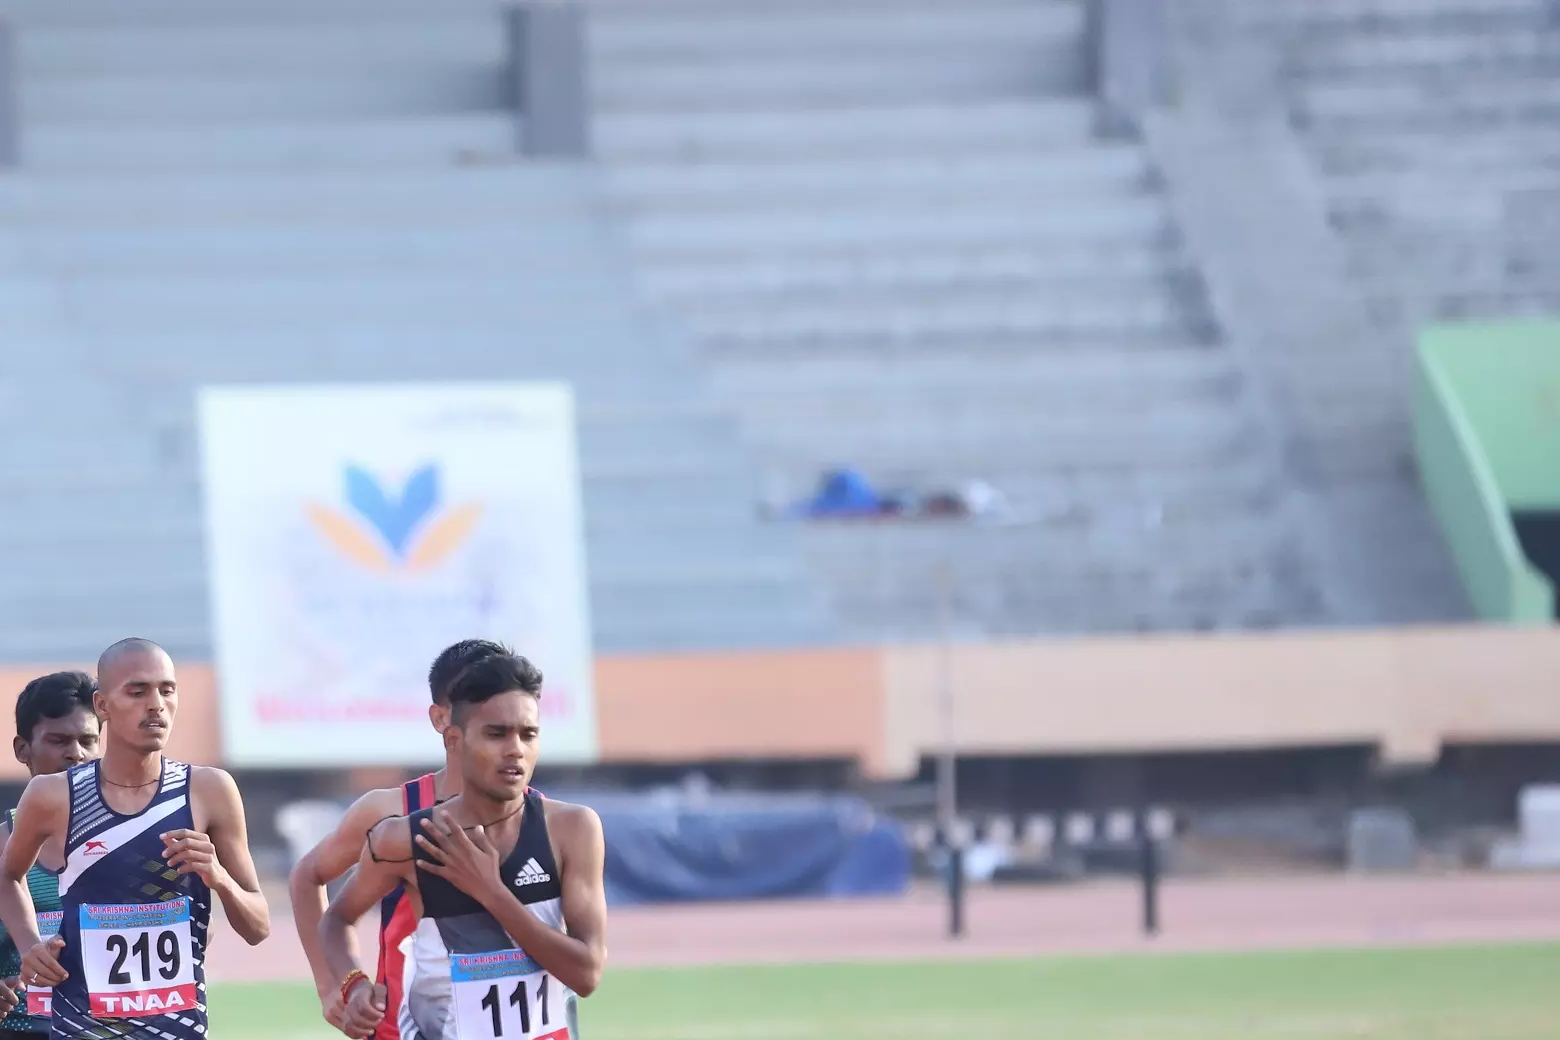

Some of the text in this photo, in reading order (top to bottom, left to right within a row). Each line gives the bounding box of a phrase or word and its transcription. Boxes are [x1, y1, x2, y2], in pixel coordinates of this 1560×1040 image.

[515, 873, 551, 886] adidas
[40, 911, 64, 920] KRISH
[89, 906, 100, 914] SRI
[102, 905, 134, 914] KRISHNA
[137, 900, 185, 912] INSTITUTIONS
[106, 930, 181, 985] 219
[100, 990, 185, 1013] TNAA
[481, 974, 550, 1038] 111
